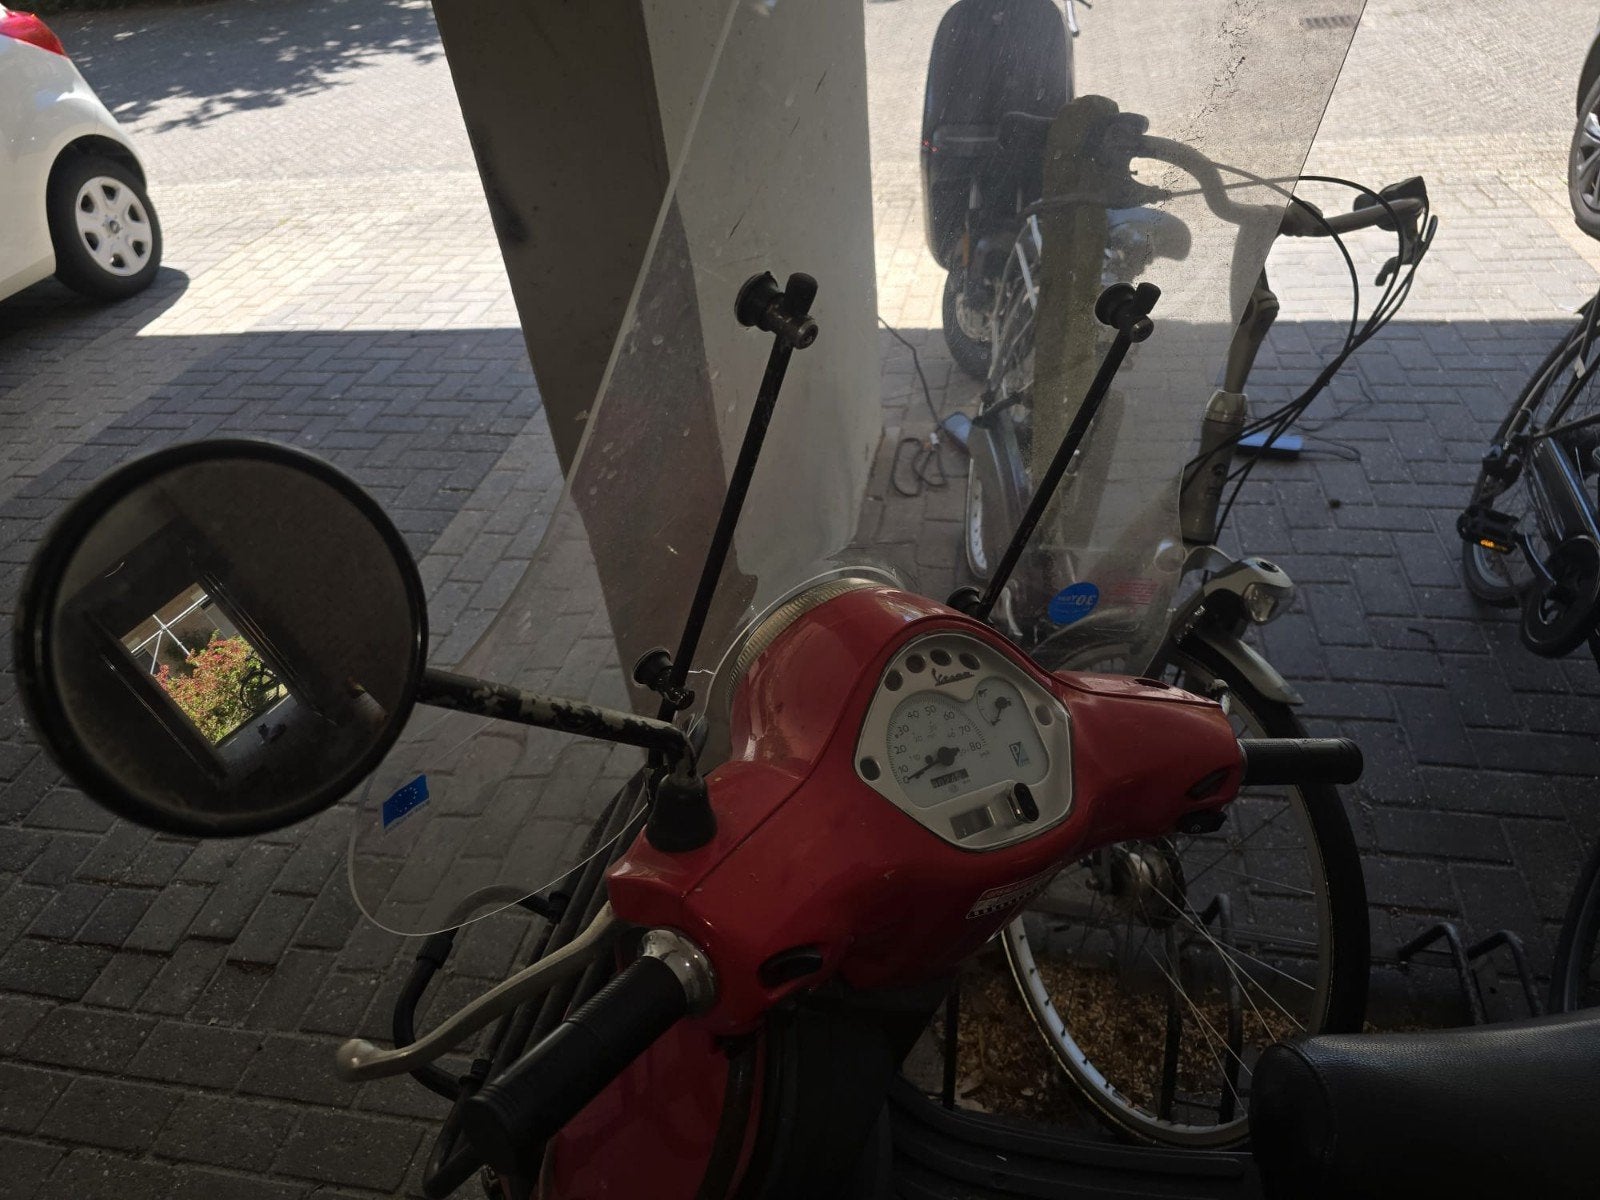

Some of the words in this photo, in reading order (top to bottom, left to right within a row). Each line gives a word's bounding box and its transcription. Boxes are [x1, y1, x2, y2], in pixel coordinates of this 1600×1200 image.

[931, 667, 975, 687] Vespa
[907, 710, 920, 719] 40
[925, 705, 937, 716] 50
[943, 711, 955, 721] 60
[898, 725, 910, 736] 30
[958, 725, 971, 736] 70
[894, 745, 907, 755] 20
[969, 742, 982, 751] 80
[898, 765, 909, 775] 10
